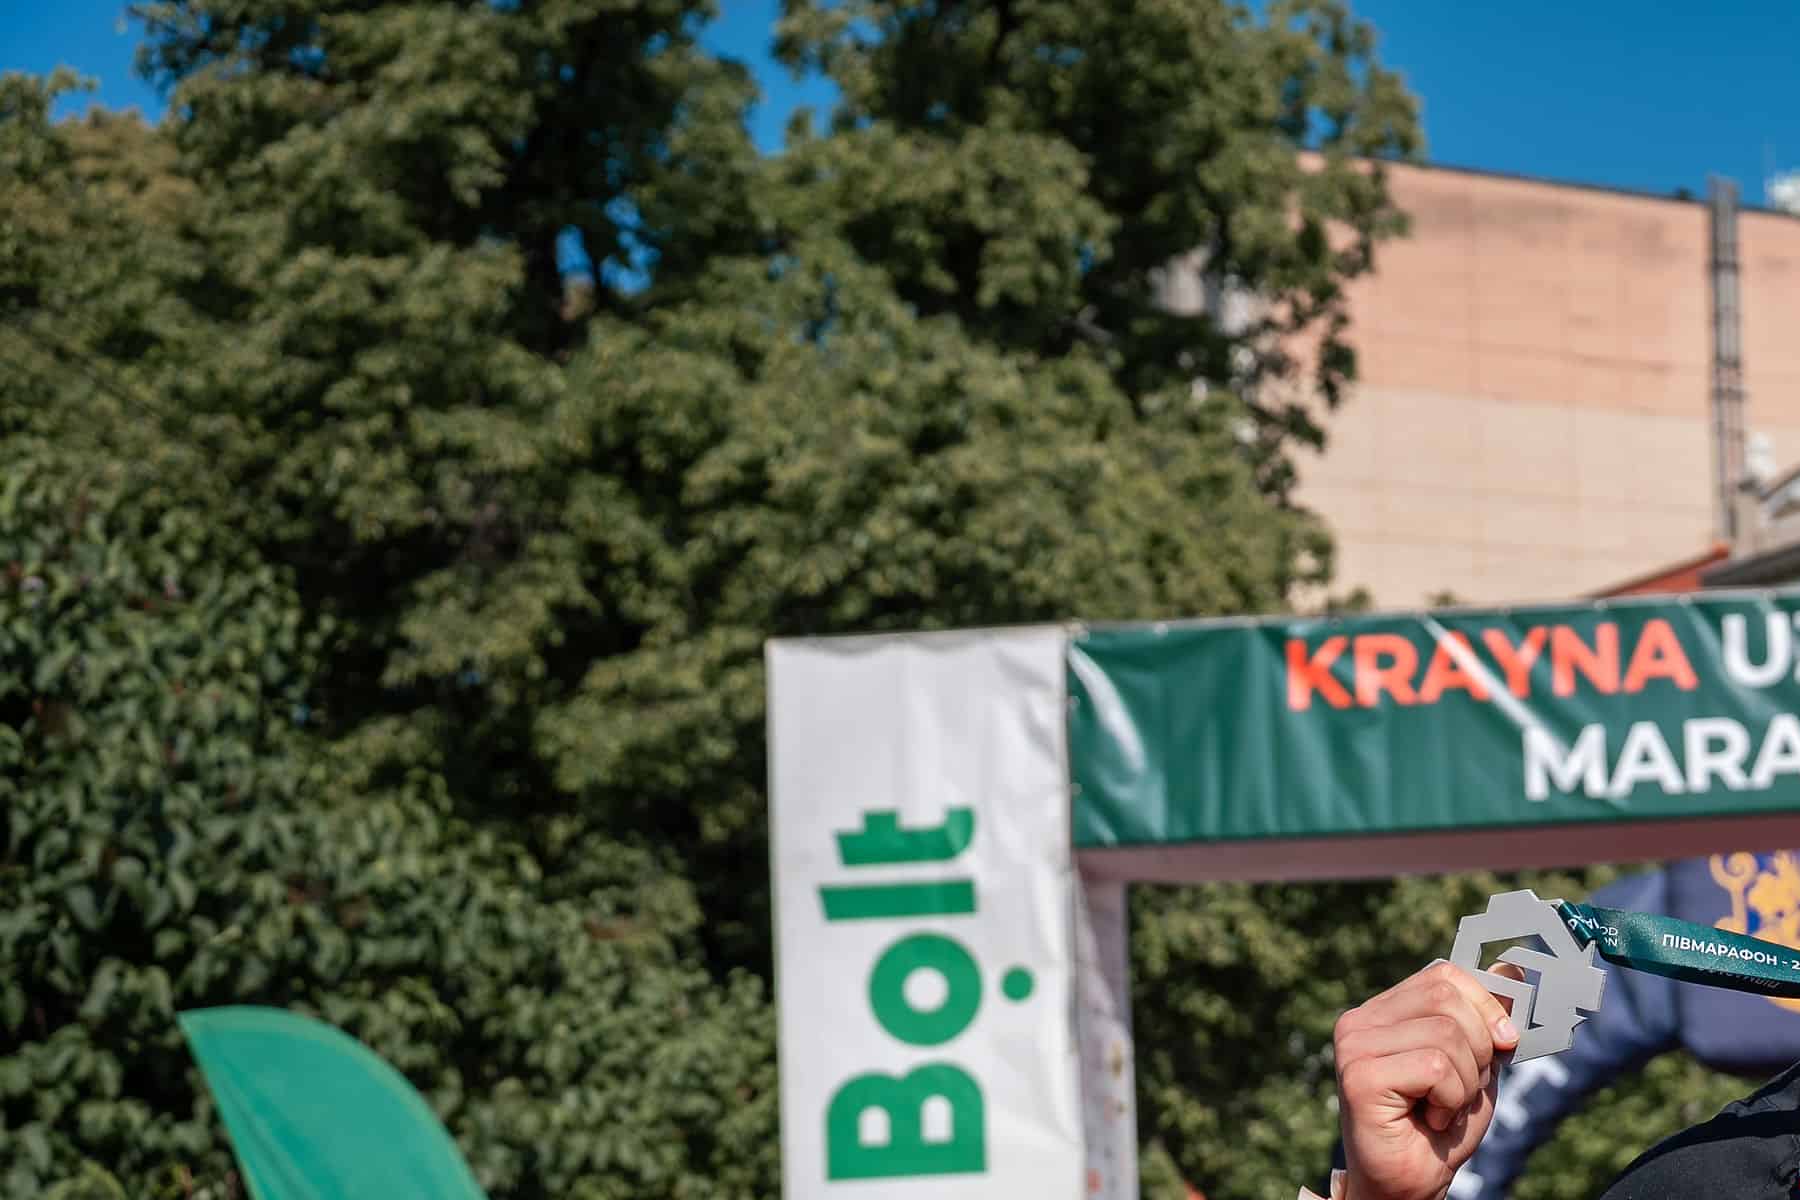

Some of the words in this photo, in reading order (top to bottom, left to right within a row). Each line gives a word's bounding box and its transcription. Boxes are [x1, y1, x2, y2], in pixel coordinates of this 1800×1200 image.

[1285, 618, 1698, 711] KRAYNA
[818, 806, 1035, 1182] Bolt
[1662, 933, 1777, 966] ПІВМАРАФОН
